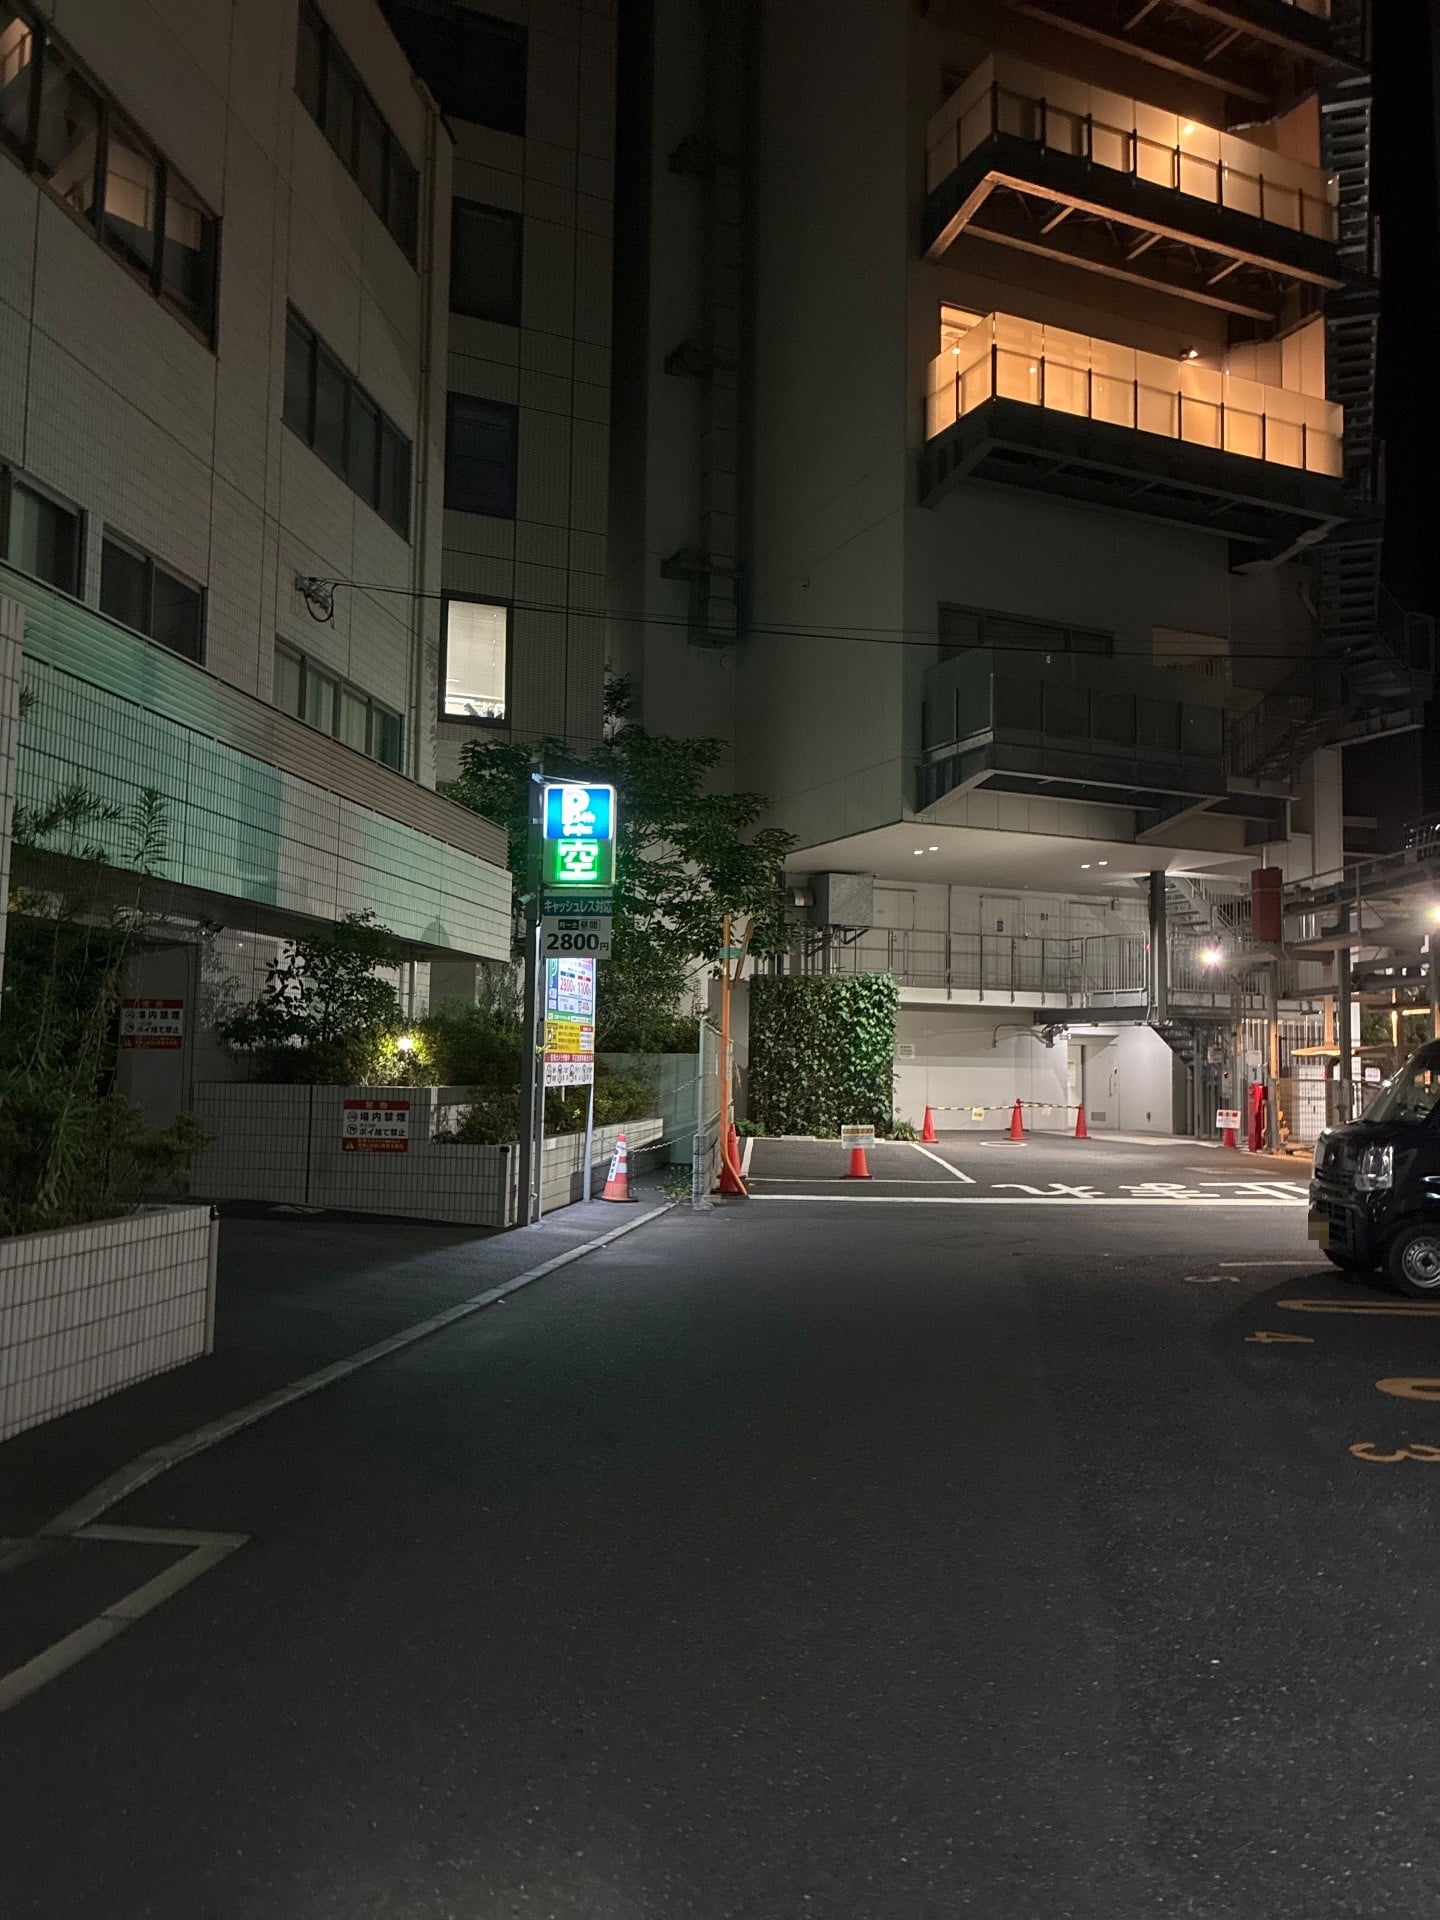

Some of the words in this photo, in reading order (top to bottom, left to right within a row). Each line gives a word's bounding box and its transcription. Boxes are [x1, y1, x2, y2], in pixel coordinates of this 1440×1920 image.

[560, 840, 599, 881] 空
[544, 899, 613, 913] キャッシュレス対応
[360, 1112, 406, 1122] 場内禁煙
[360, 1128, 405, 1137] ポイ捨て禁止
[990, 1181, 1310, 1200] 止まれ
